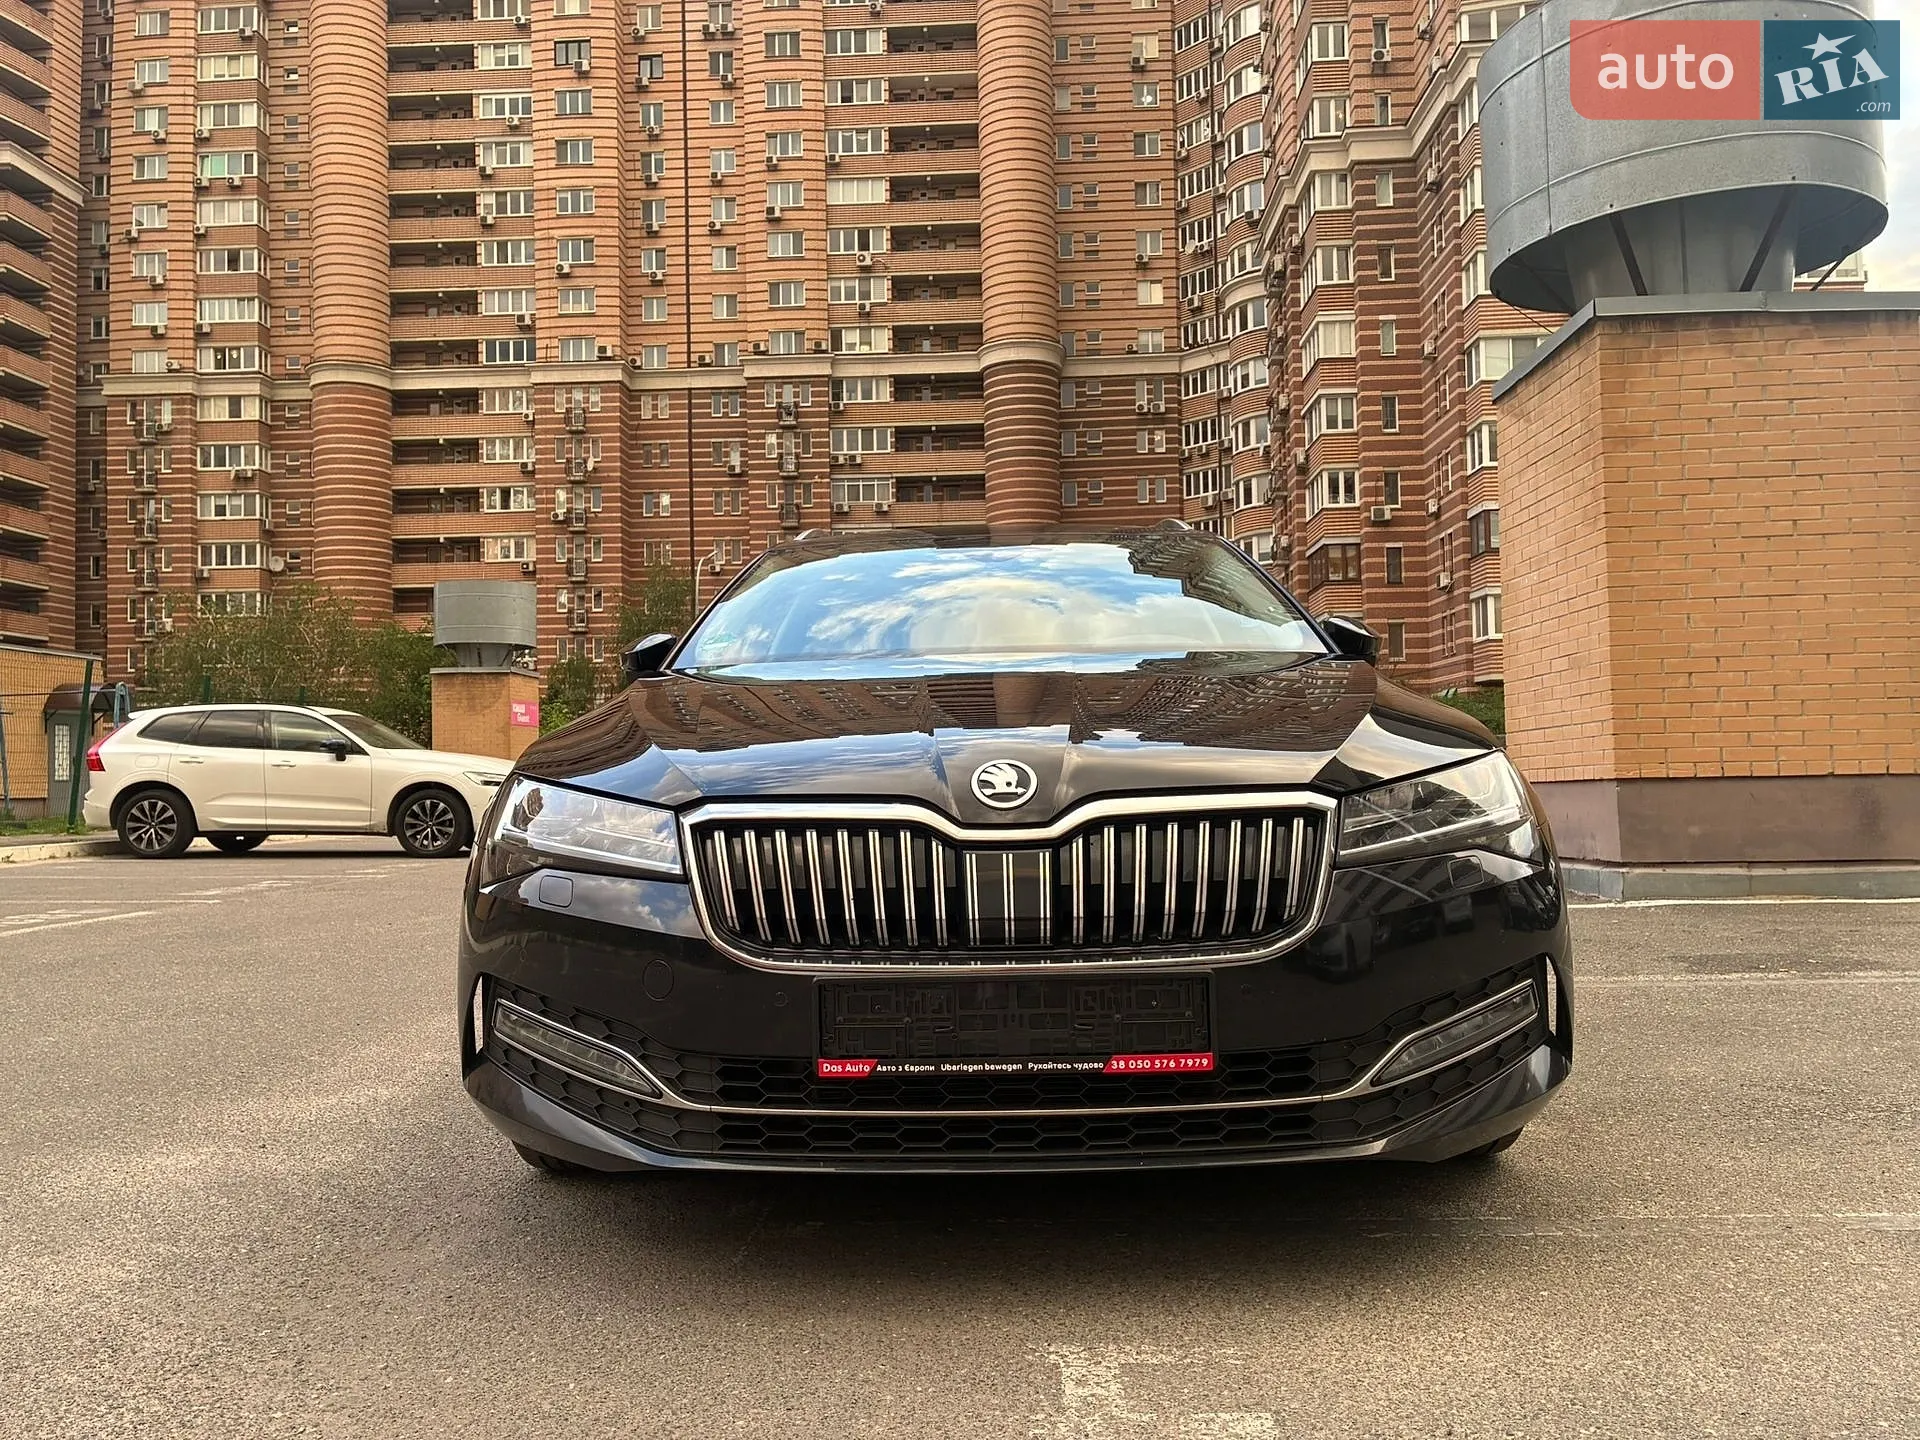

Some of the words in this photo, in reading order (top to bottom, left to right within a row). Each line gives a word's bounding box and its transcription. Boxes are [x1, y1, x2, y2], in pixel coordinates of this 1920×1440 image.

[823, 1063, 843, 1072] Das
[845, 1063, 870, 1072] Auto
[876, 1064, 897, 1072] Авто
[1028, 1061, 1072, 1072] Рухайтесь
[1073, 1062, 1104, 1071] чудово
[1111, 1060, 1126, 1069] 38
[1128, 1059, 1151, 1069] 050
[1154, 1059, 1176, 1068] 576
[1179, 1058, 1209, 1067] 7979
